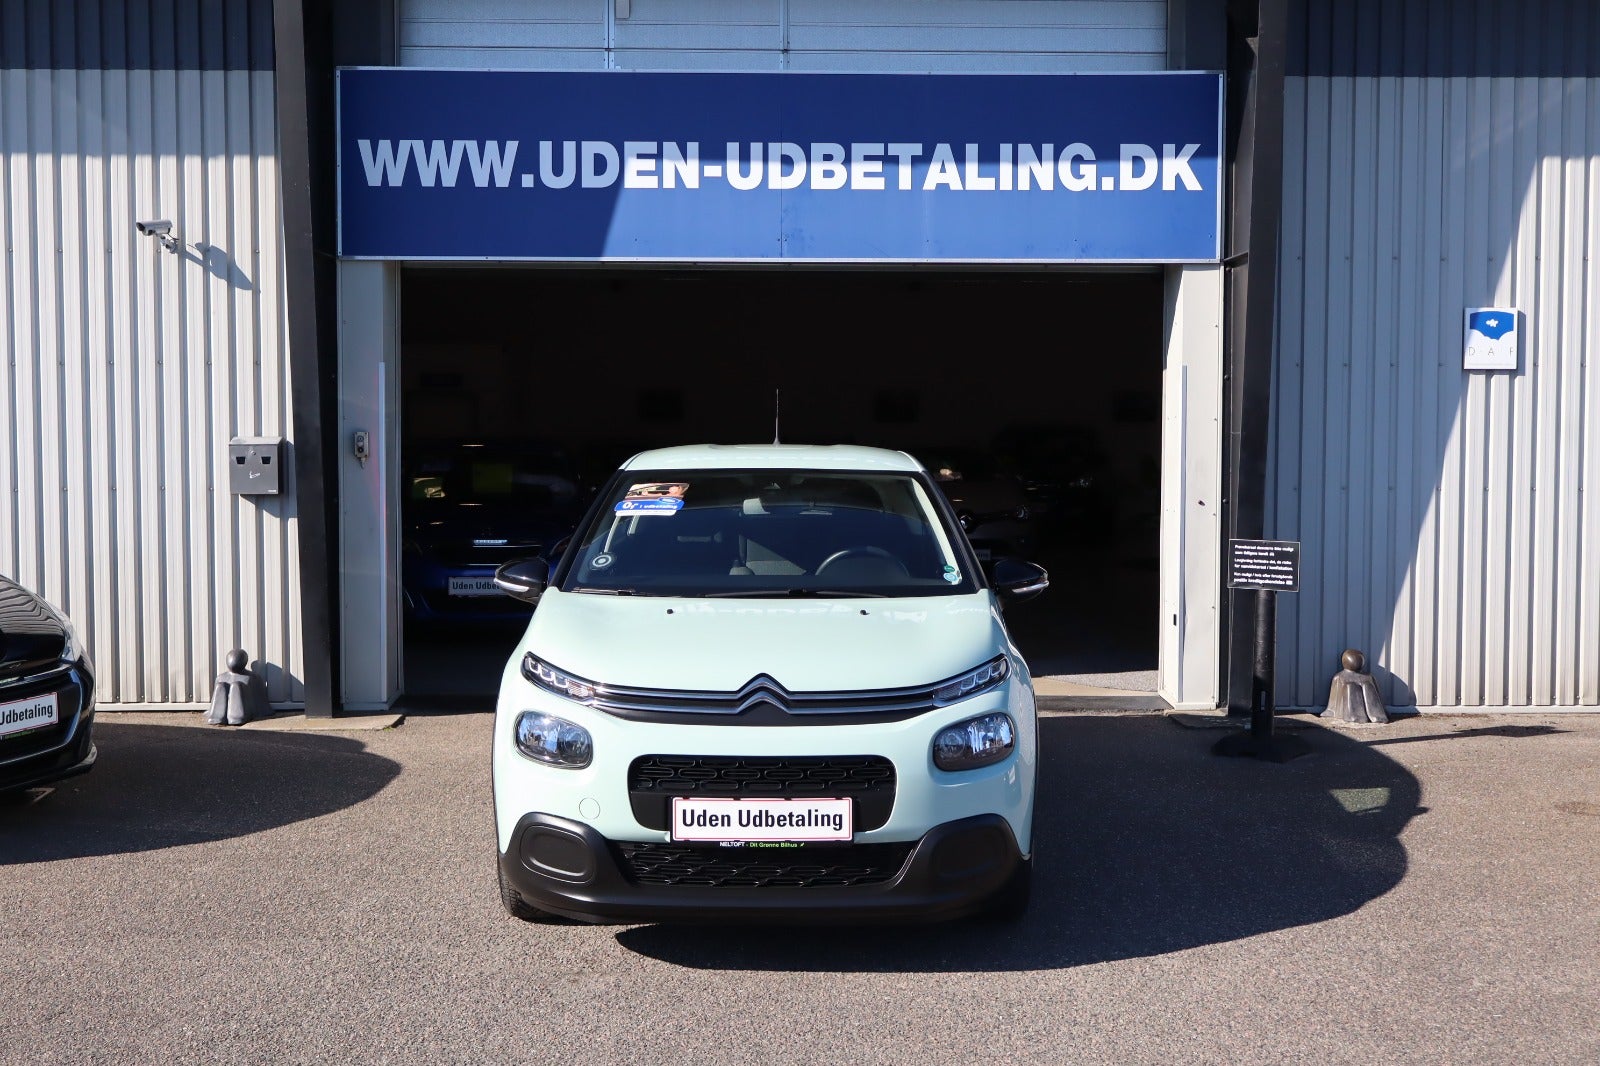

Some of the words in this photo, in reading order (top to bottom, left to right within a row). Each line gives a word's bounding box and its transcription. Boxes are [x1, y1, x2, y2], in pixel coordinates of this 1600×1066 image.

[357, 139, 1203, 192] WWW.UDEN-UDBETALING.DK
[452, 581, 474, 590] Uden
[682, 809, 731, 828] Uden
[738, 809, 844, 831] Udbetaling
